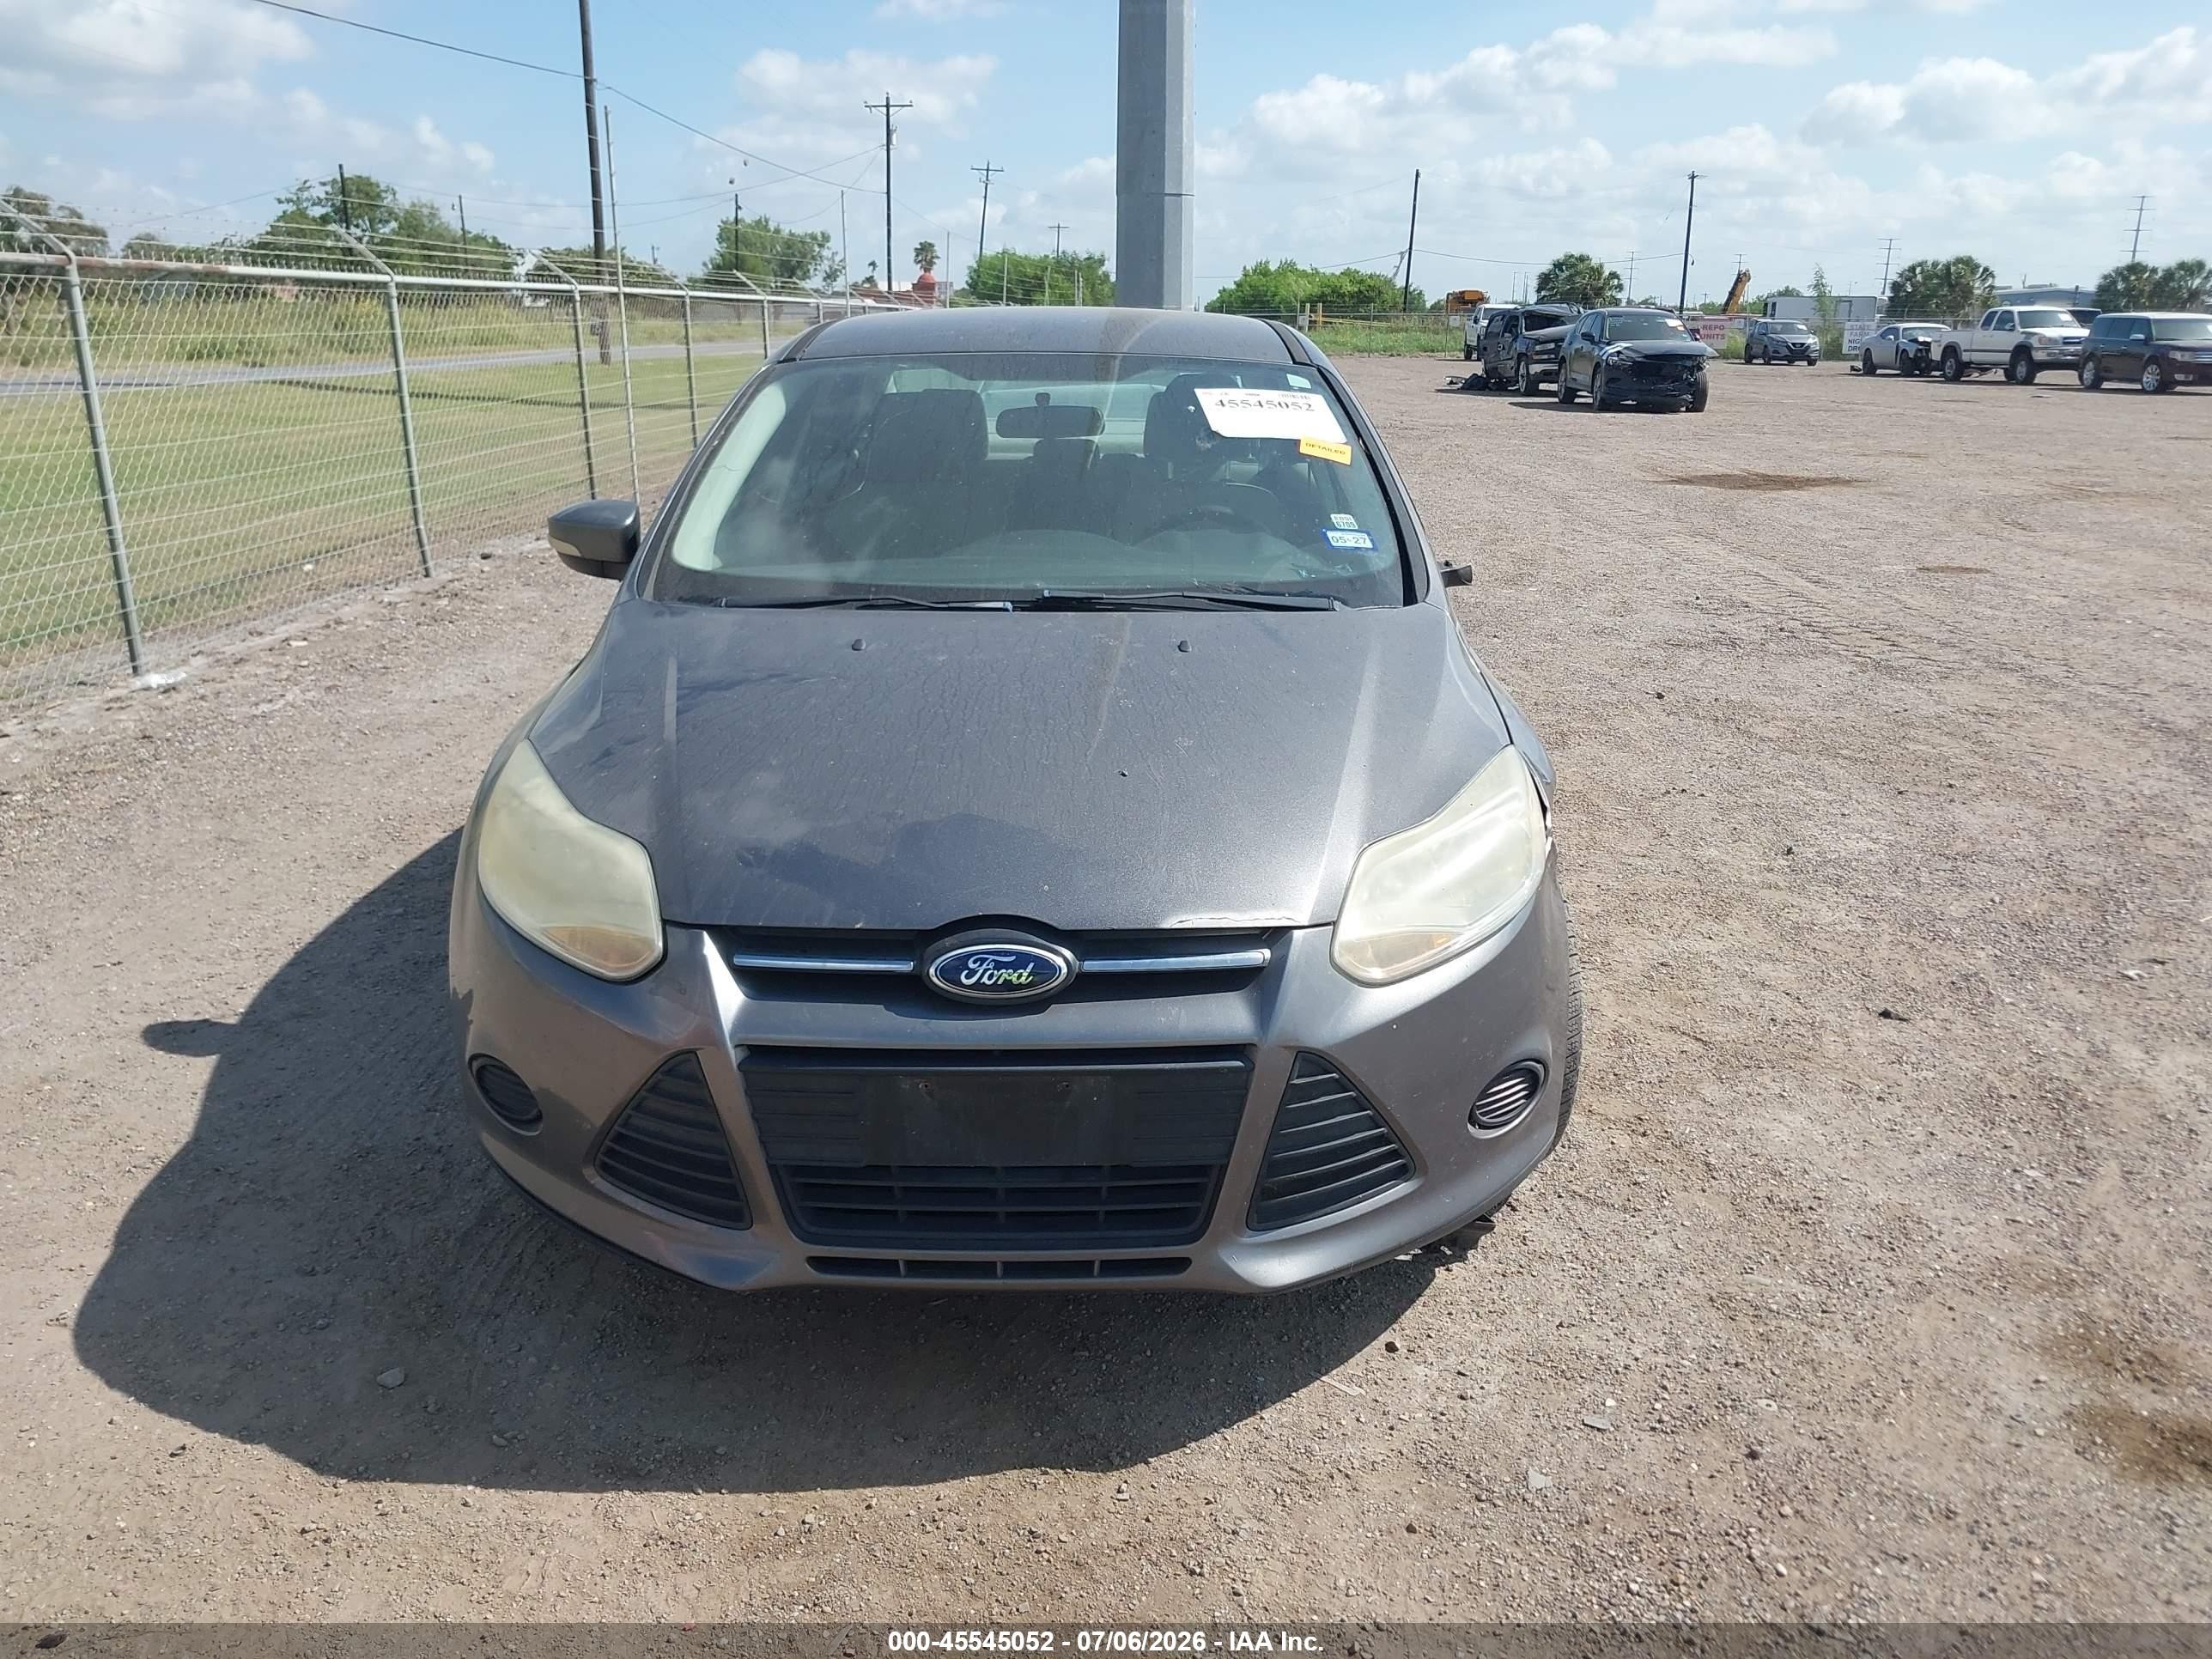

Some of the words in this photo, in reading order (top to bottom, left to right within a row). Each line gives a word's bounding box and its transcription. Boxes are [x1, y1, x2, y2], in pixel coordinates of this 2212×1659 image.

[1214, 398, 1315, 412] 45545052
[1305, 441, 1346, 455] DETAILED
[960, 954, 1036, 986] Ford
